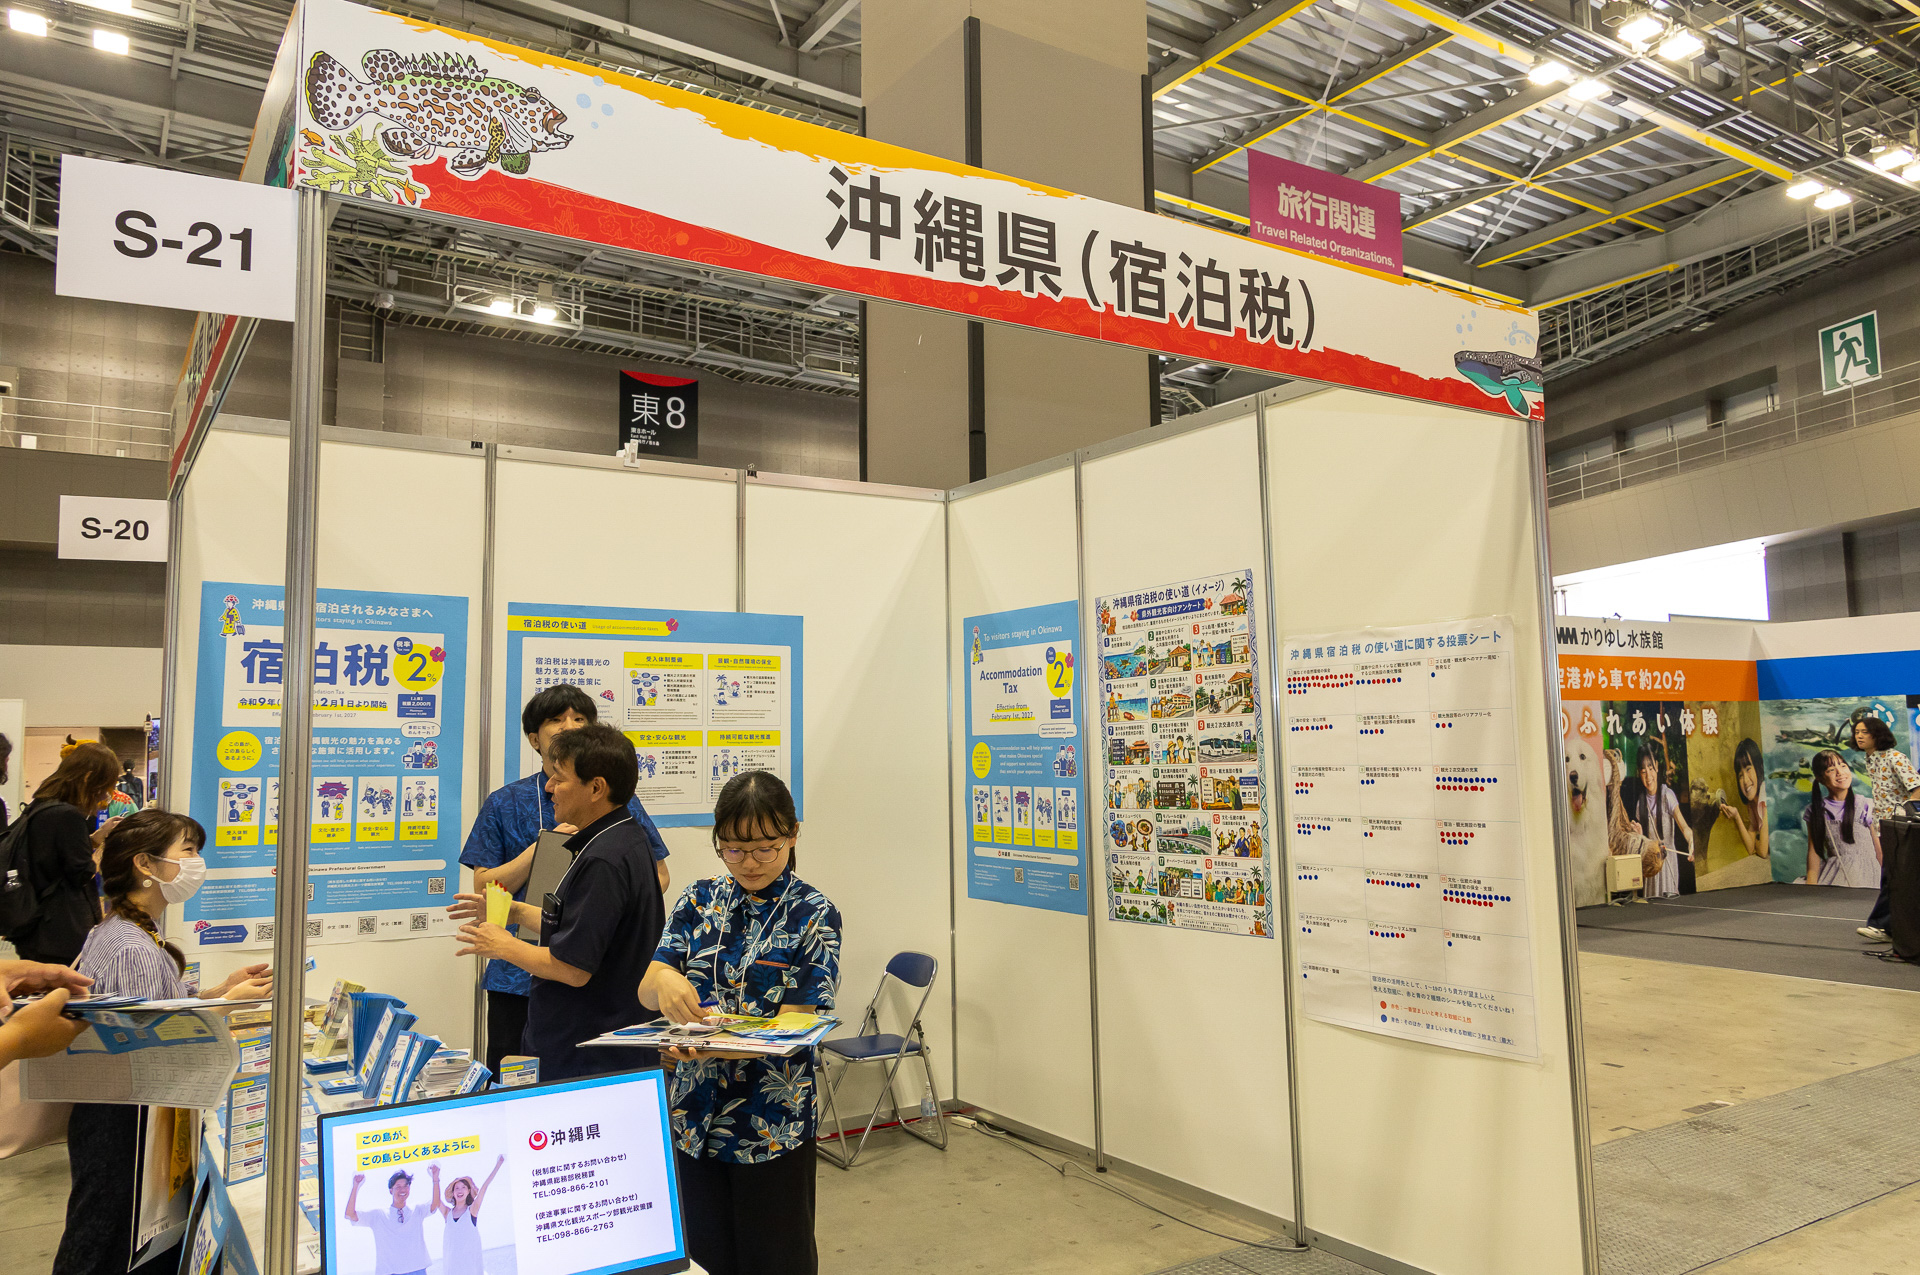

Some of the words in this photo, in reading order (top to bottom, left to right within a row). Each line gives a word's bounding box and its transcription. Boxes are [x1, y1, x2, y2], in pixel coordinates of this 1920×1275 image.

[1278, 182, 1376, 240] 旅行関連
[114, 210, 253, 272] S-21
[1255, 221, 1287, 240] Travel
[1290, 230, 1327, 250] Related
[1330, 240, 1395, 268] Organizations,
[81, 517, 150, 541] S-20
[1141, 602, 1201, 619] 県外観光客向けアンケート
[524, 619, 587, 630] 宿泊税の使い道
[984, 634, 990, 642] To
[991, 631, 1010, 641] visitors
[1012, 629, 1030, 639] staying
[1038, 625, 1062, 635] Okinawa
[1290, 631, 1502, 661] 沖縄県宿泊税の使い道に関する投票シート
[1581, 628, 1664, 649] かりゆし水族館
[535, 657, 610, 666] 宿泊税は沖縄観光の
[535, 667, 585, 676] 魅力を高める
[980, 666, 1042, 681] Accommodation
[535, 678, 601, 686] さまざまな施策に
[1003, 682, 1018, 694] Tax
[992, 713, 1011, 721] February
[362, 1130, 407, 1146] この島が、
[551, 1123, 601, 1146] 沖縄県
[362, 1142, 476, 1166] この島らしくあるように。
[532, 1170, 595, 1188] 沖縄県総務部税務課
[533, 1179, 609, 1199] TEL:098-866-2101
[536, 1202, 653, 1232] 沖縄県文化観光スポーツ部観光政策課
[537, 1221, 614, 1243] TEL:098-866-2763
